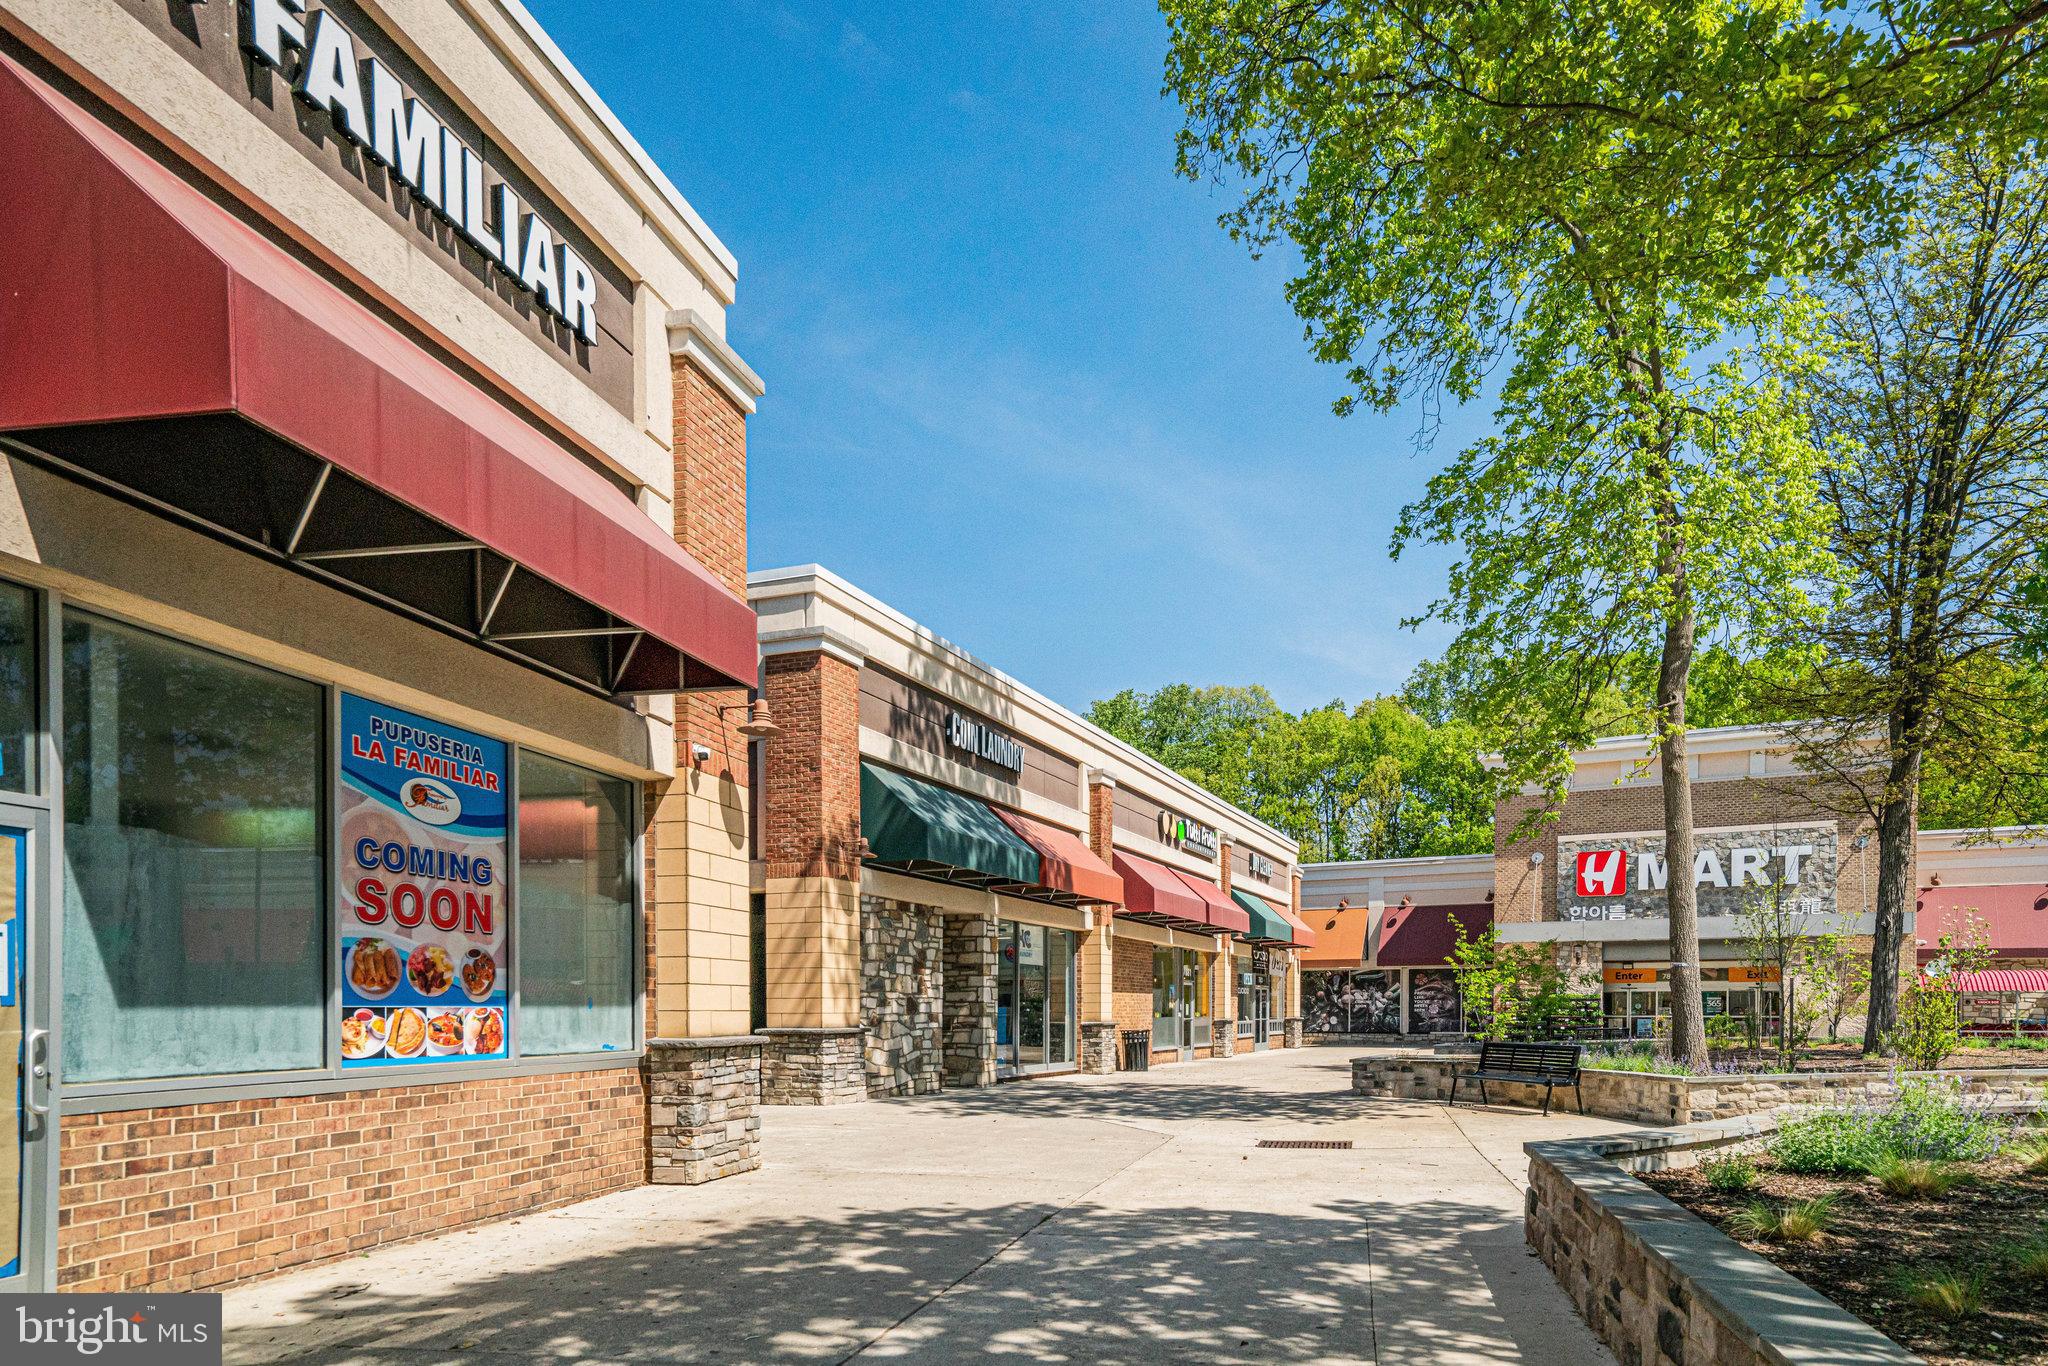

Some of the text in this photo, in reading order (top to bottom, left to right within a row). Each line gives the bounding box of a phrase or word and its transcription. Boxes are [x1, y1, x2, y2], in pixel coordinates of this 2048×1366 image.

[252, 0, 598, 346] FAMILIAR
[352, 734, 500, 794] LA FAMILIAR
[370, 715, 484, 767] PUPUSERIA
[952, 712, 1026, 775] COIN LAUNDRY
[355, 836, 492, 885] COMING
[1580, 845, 1813, 896] H MART
[355, 876, 493, 935] SOON
[1569, 904, 1626, 922] 한아름
[1615, 971, 1643, 981] Enter
[1747, 970, 1769, 979] Exit
[1706, 999, 1722, 1008] 365
